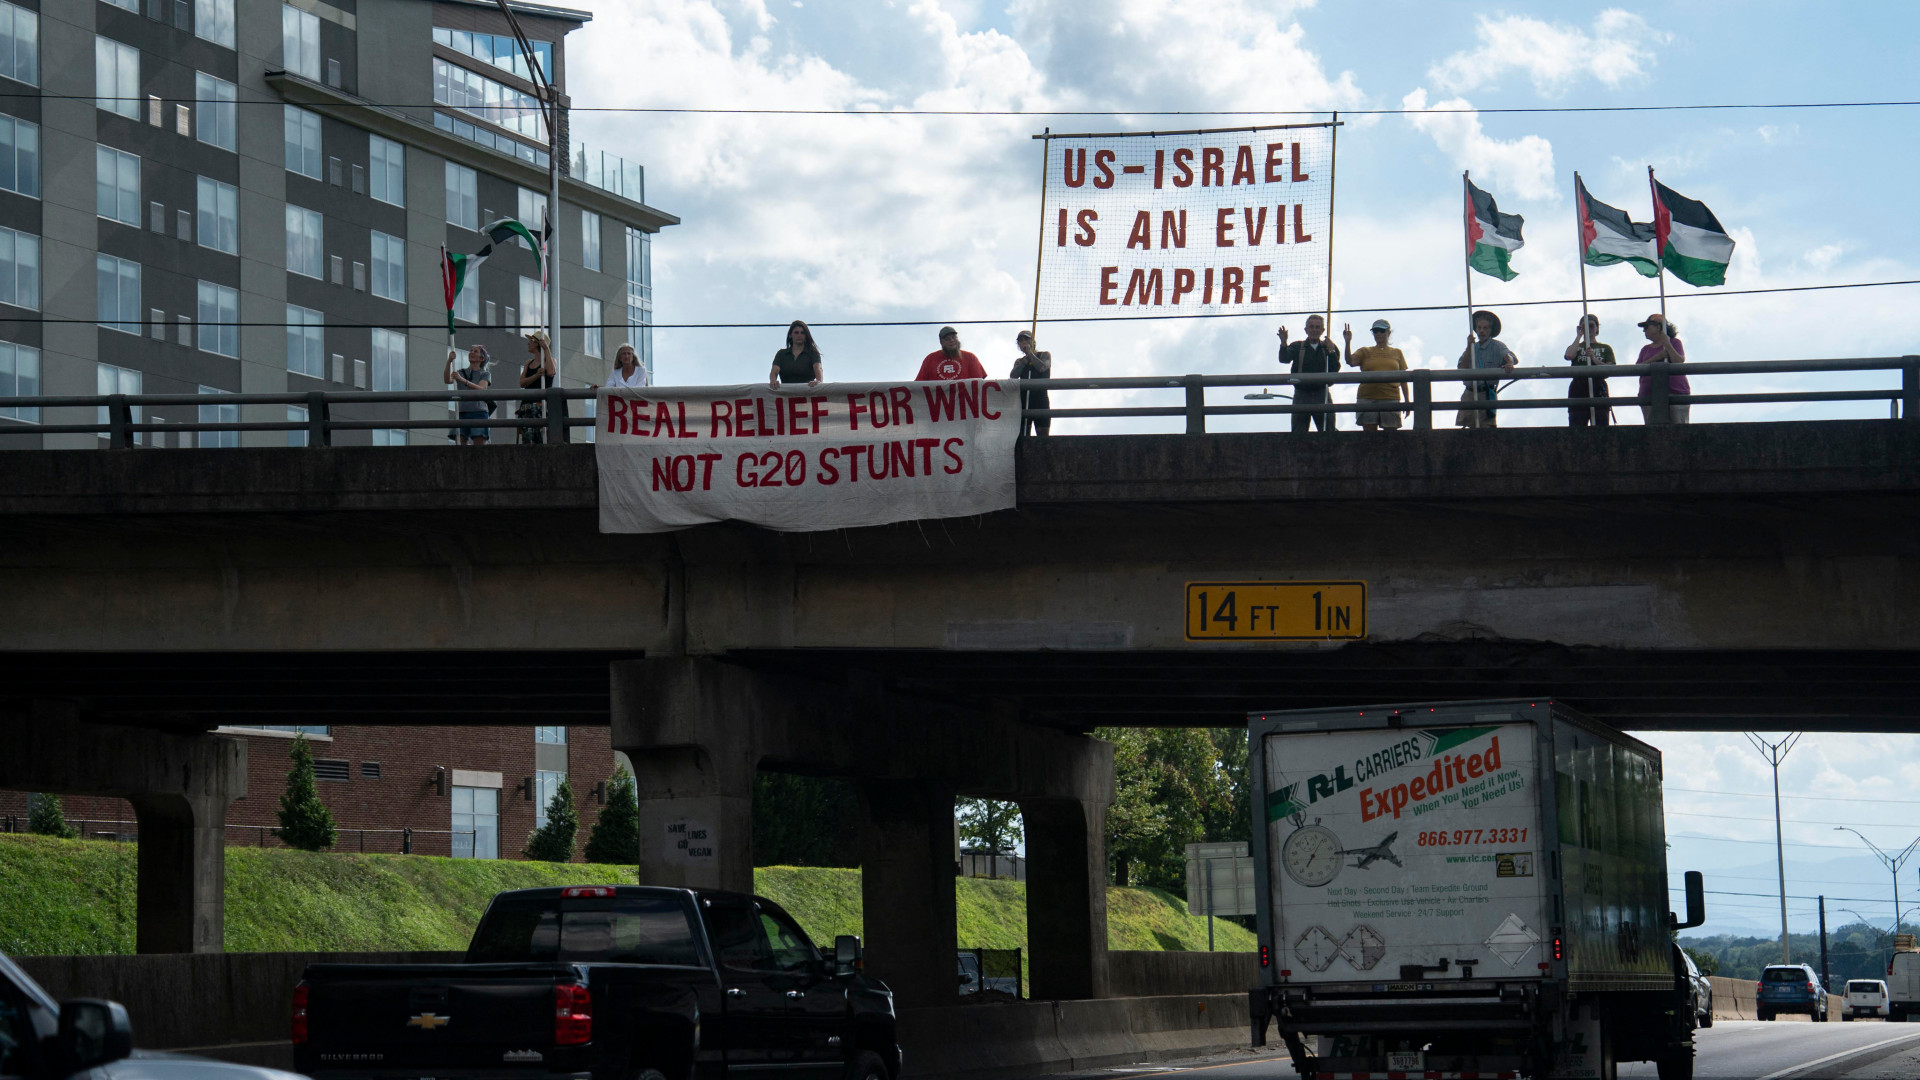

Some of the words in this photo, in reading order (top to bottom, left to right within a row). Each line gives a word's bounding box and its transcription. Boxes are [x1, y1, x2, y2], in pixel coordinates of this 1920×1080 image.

[1064, 142, 1309, 189] US-ISRAEL
[1057, 208, 1098, 247] IS
[1126, 209, 1187, 250] AN
[1216, 204, 1312, 247] EVIL
[1099, 264, 1271, 306] EMPIRE
[608, 395, 698, 438] REAL
[711, 396, 829, 438] RELIEF
[847, 386, 914, 430] FOR
[923, 380, 1002, 422] WNC
[652, 453, 722, 492] NOT
[736, 449, 806, 489] G20
[816, 438, 964, 486] STUNTS
[1198, 591, 1238, 631] 14
[1251, 606, 1280, 631] FT
[1312, 591, 1322, 630] 1
[1327, 606, 1350, 630] IN
[1307, 764, 1354, 804] R+L
[1356, 737, 1421, 782] CARRIERS
[1359, 735, 1502, 823] Expedited
[1412, 799, 1440, 817] When
[1441, 791, 1459, 806] You
[1461, 780, 1486, 799] Need
[1488, 777, 1495, 788] it
[1497, 769, 1521, 785] Now,
[1461, 797, 1479, 810] You
[1481, 786, 1506, 802] Need
[1508, 778, 1525, 792] Us!
[668, 824, 686, 833] SAVE
[678, 839, 689, 849] GO
[687, 829, 707, 840] LIVES
[1417, 827, 1528, 847] 866.977.3331
[688, 847, 712, 857] VEGAN
[1327, 887, 1342, 896] Next
[1344, 887, 1357, 897] Day
[1363, 886, 1390, 895] Second
[1391, 885, 1405, 895] Day
[1411, 884, 1429, 893] Team
[1431, 884, 1461, 894] Expedite
[1462, 883, 1488, 892] Ground
[1341, 899, 1361, 907] Shots
[1367, 898, 1399, 907] Exclusive
[1401, 898, 1415, 906] Use
[1416, 896, 1441, 905] Vehicle
[1447, 896, 1457, 904] Air
[1458, 895, 1489, 904] Charters
[1353, 910, 1384, 919] Weekend
[1386, 909, 1412, 918] Service
[1418, 908, 1434, 917] 24/7
[1436, 908, 1464, 918] Support
[320, 1053, 384, 1061] SILVERADO
